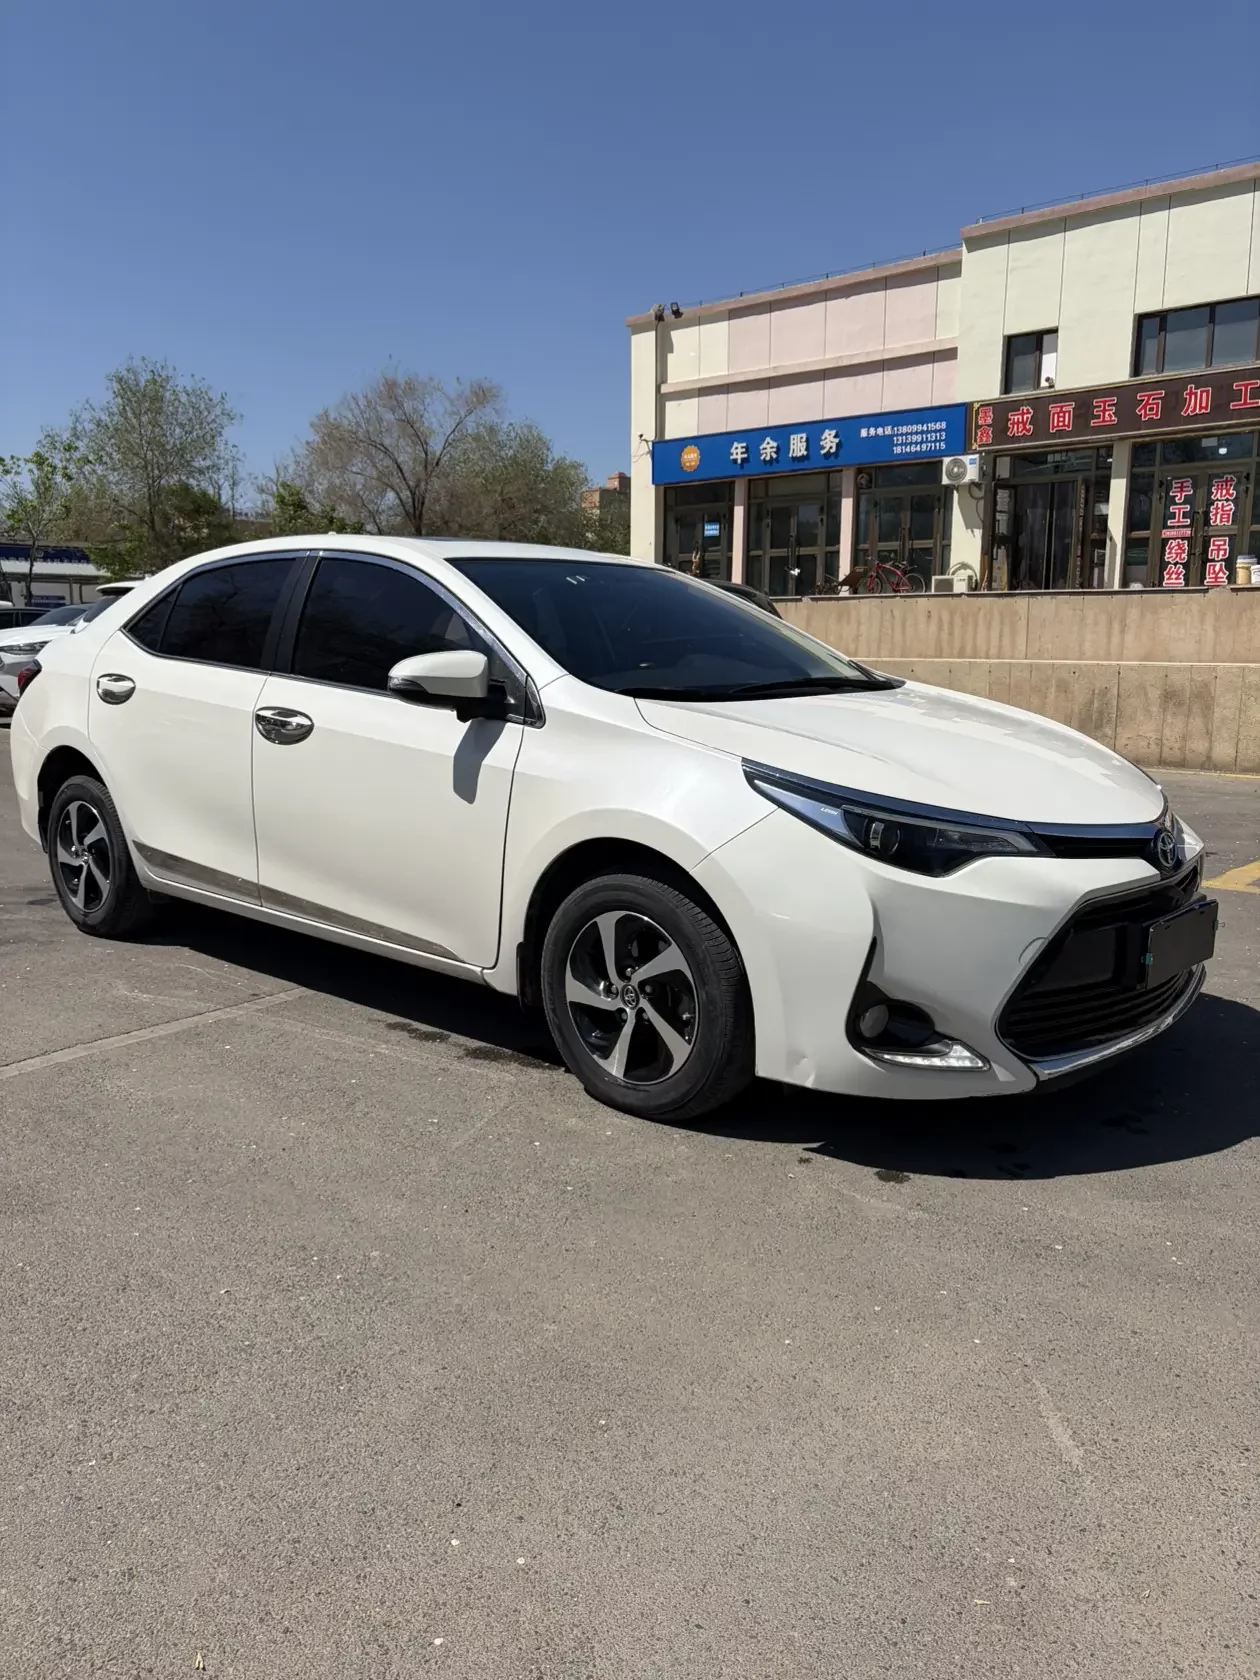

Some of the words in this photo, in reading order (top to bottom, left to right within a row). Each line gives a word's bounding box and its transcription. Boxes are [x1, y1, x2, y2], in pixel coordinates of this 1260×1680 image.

[1008, 380, 1260, 436] 戒面玉石加工
[730, 429, 839, 465] 年余服务
[893, 432, 946, 444] 13139911313
[893, 442, 946, 454] 18146497115
